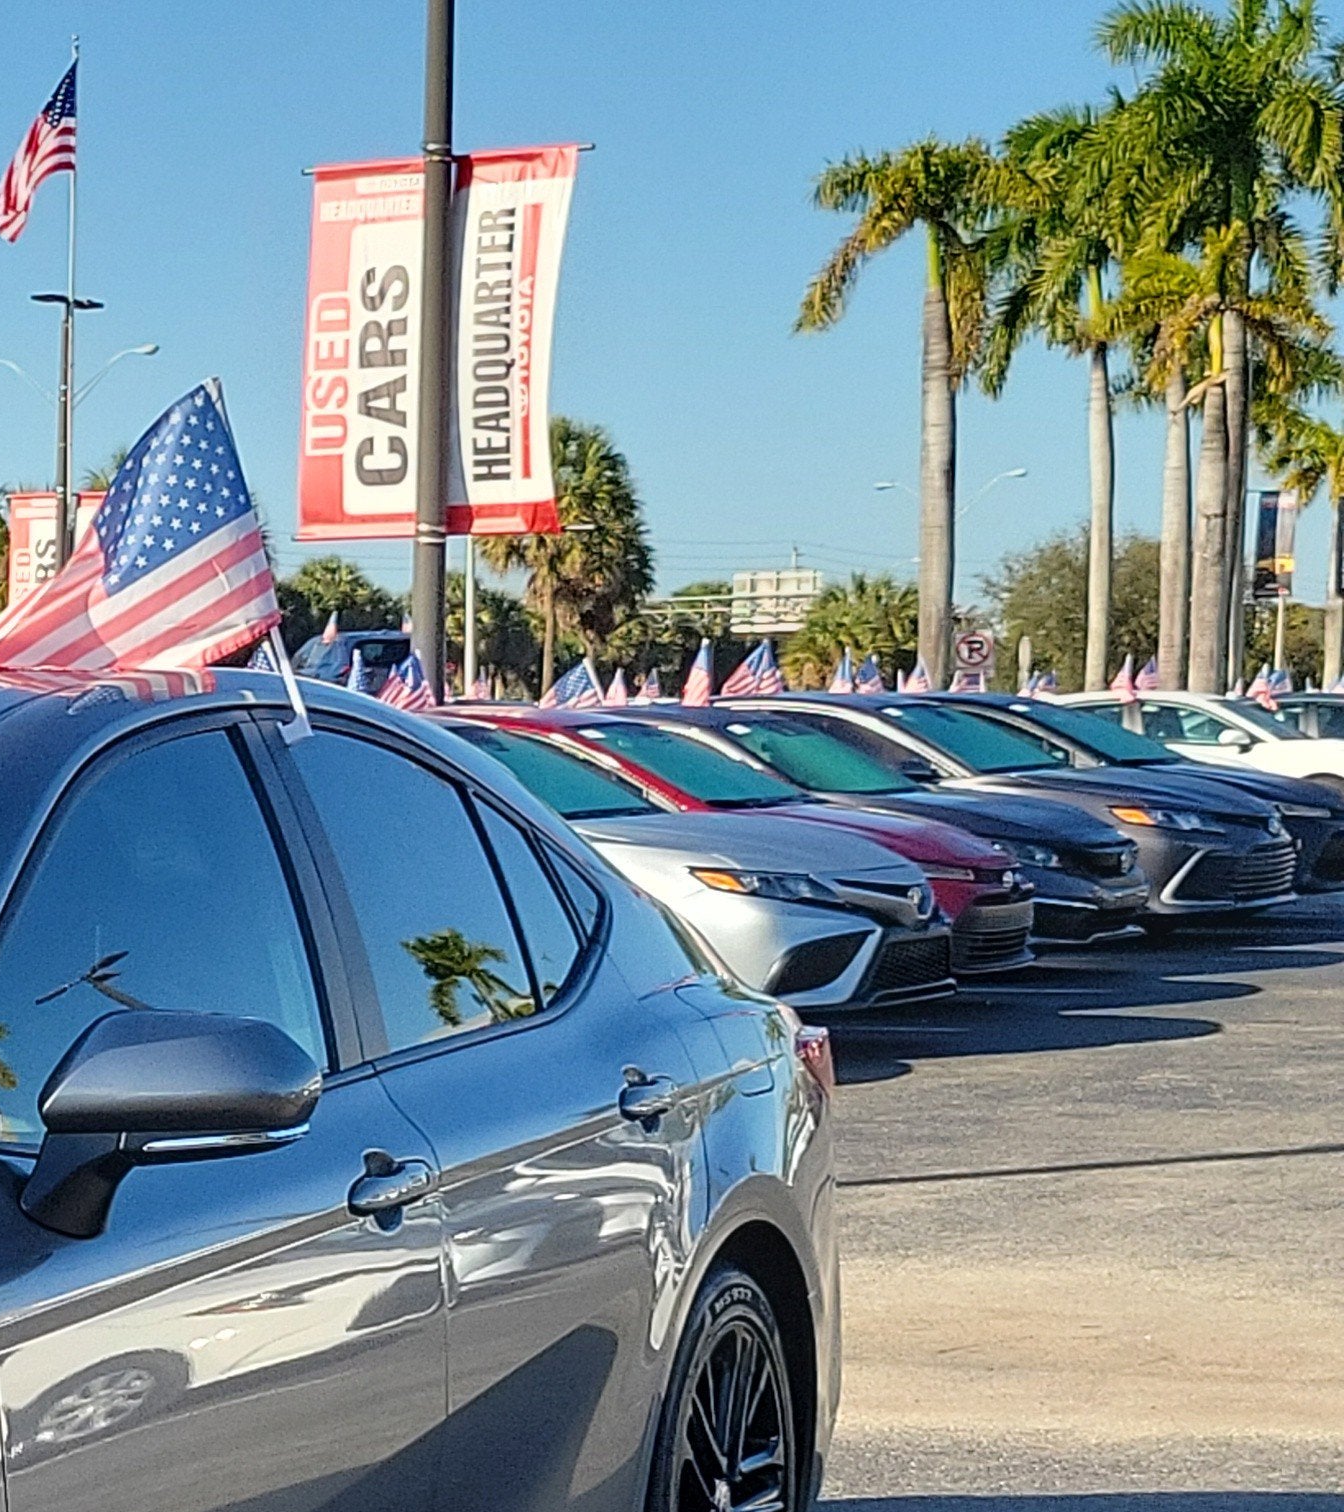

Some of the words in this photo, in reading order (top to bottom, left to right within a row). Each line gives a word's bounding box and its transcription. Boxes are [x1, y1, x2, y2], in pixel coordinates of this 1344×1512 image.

[311, 296, 350, 449] USED
[355, 264, 410, 486] CARS
[472, 206, 516, 482] HEADQUARTER
[517, 275, 535, 386] TOYOTA
[15, 552, 31, 600] SED
[35, 539, 59, 584] RS
